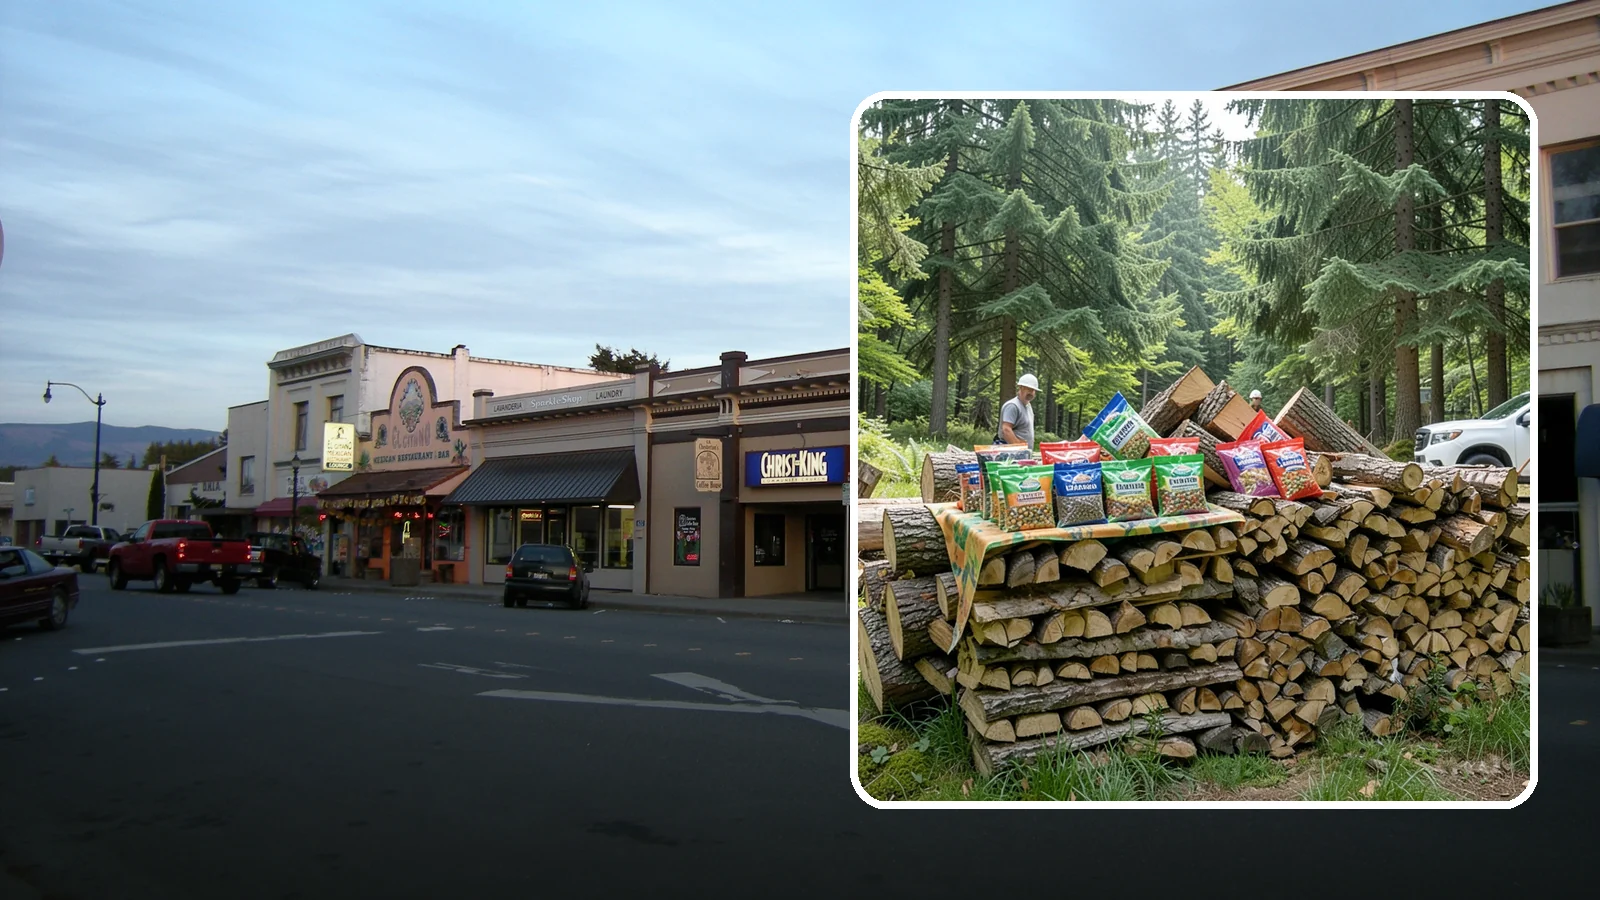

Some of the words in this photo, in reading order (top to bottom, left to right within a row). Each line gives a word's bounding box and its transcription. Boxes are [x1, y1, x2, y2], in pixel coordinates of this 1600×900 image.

[531, 397, 561, 409] Sparkle
[562, 394, 582, 404] Shop
[596, 389, 623, 400] LAUNDRY
[493, 402, 522, 412] LAVANDERIA
[374, 455, 396, 464] MEXICAN
[397, 451, 433, 462] RESTAURANT
[438, 450, 450, 459] BAR
[761, 452, 798, 478] CHRIST
[799, 450, 827, 476] KING
